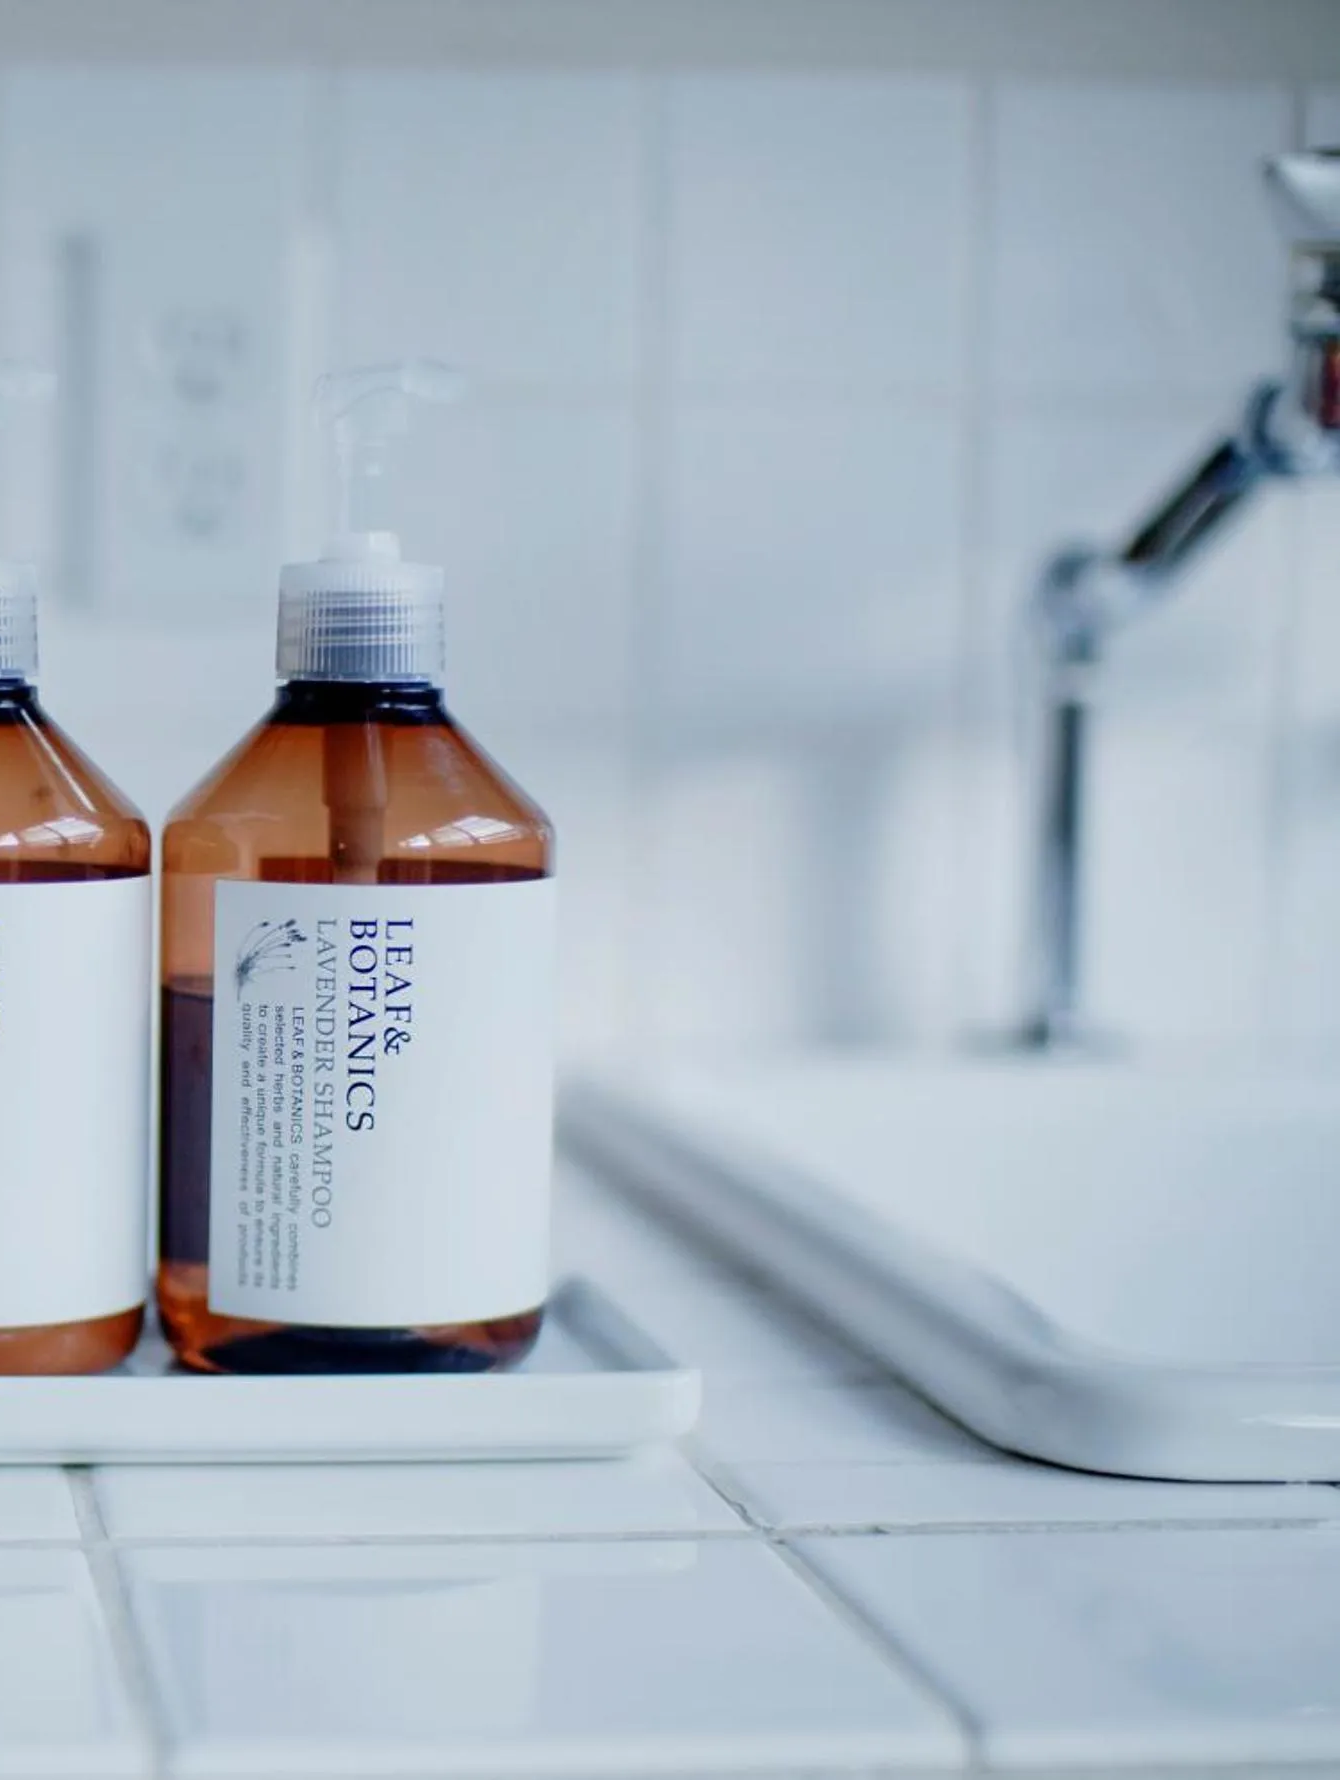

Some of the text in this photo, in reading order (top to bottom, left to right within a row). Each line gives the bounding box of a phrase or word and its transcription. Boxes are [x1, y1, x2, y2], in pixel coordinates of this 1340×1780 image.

[384, 919, 413, 1055] LEAF&
[239, 1003, 253, 1050] quality
[258, 1005, 269, 1018] to
[292, 1007, 304, 1048] LEAF
[346, 919, 378, 1131] BOTANICS
[257, 1024, 269, 1067] create
[274, 1006, 286, 1065] selected
[292, 1051, 303, 1060] &
[241, 1061, 253, 1087] and
[257, 1074, 266, 1082] a
[273, 1073, 285, 1113] herbs
[311, 920, 337, 1228] LAVENDER SHAMPOO
[254, 1088, 268, 1136] unique
[290, 1064, 303, 1144] BOTANICS
[273, 1122, 284, 1148] and
[255, 1142, 268, 1194] formula
[272, 1156, 284, 1205] natural
[288, 1153, 303, 1214] carefully
